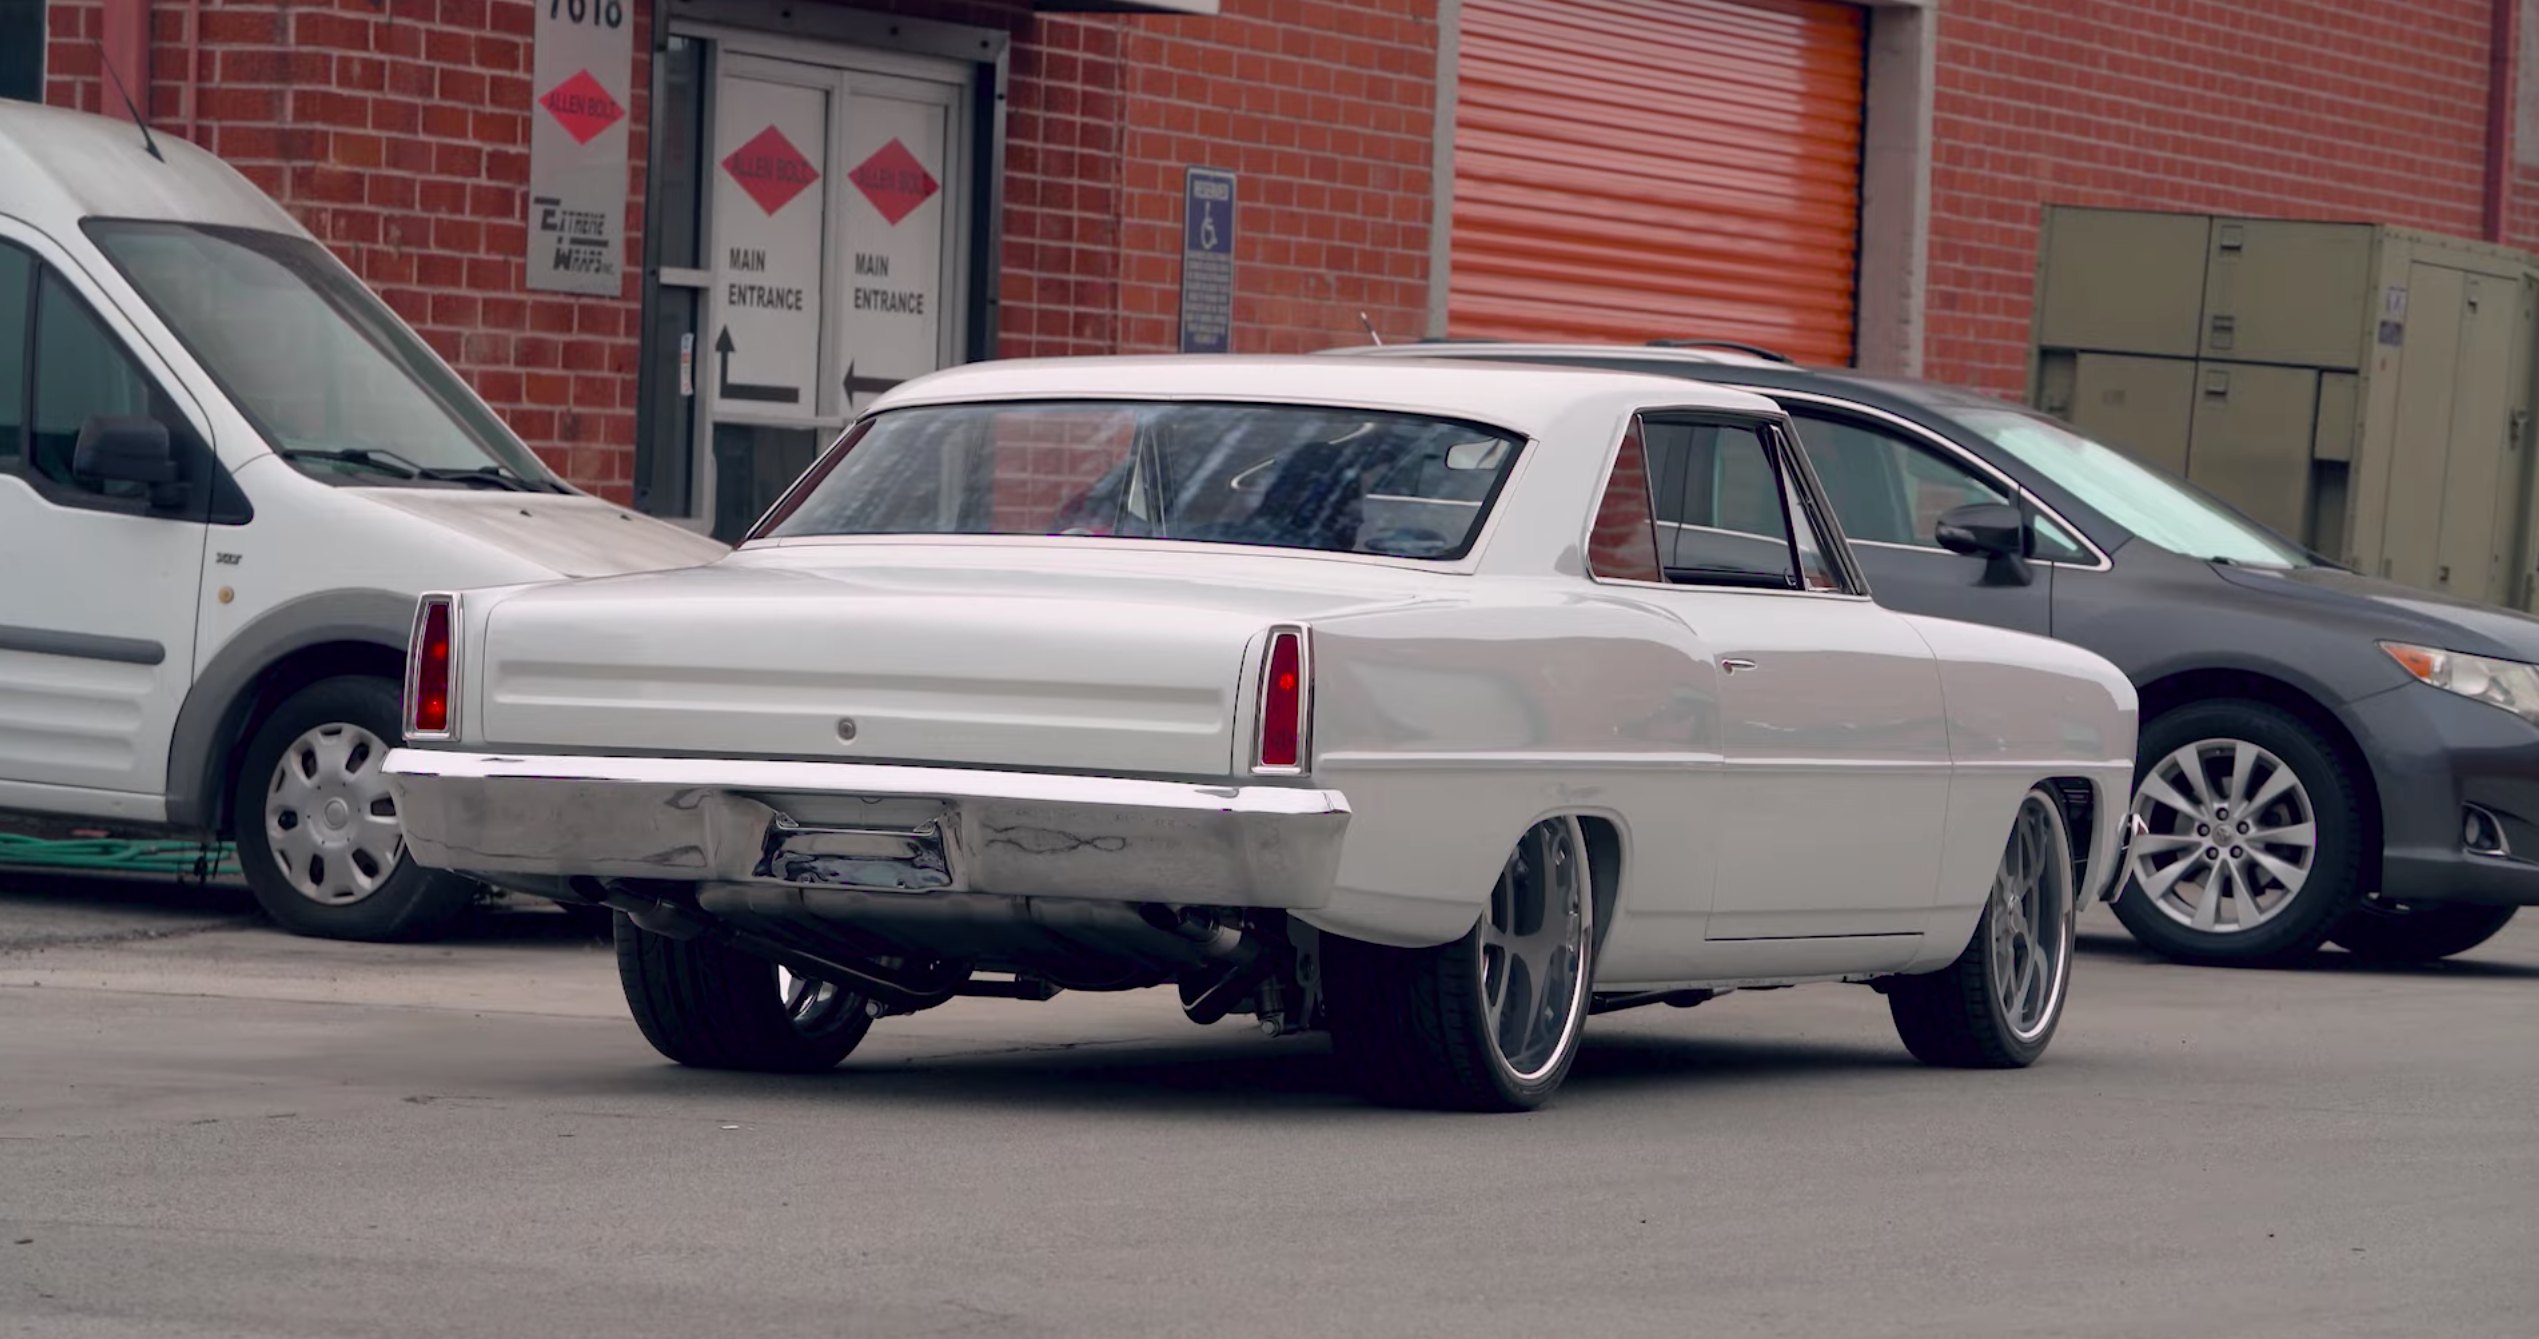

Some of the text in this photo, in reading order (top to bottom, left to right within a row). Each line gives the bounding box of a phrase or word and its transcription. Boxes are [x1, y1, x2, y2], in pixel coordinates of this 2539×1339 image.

[547, 92, 585, 115] ALLEN
[731, 152, 772, 180] ALLEN
[728, 247, 766, 273] MAIN
[854, 252, 890, 278] MAIN
[728, 282, 803, 312] ENTRANCE
[853, 287, 925, 316] ENTRANCE
